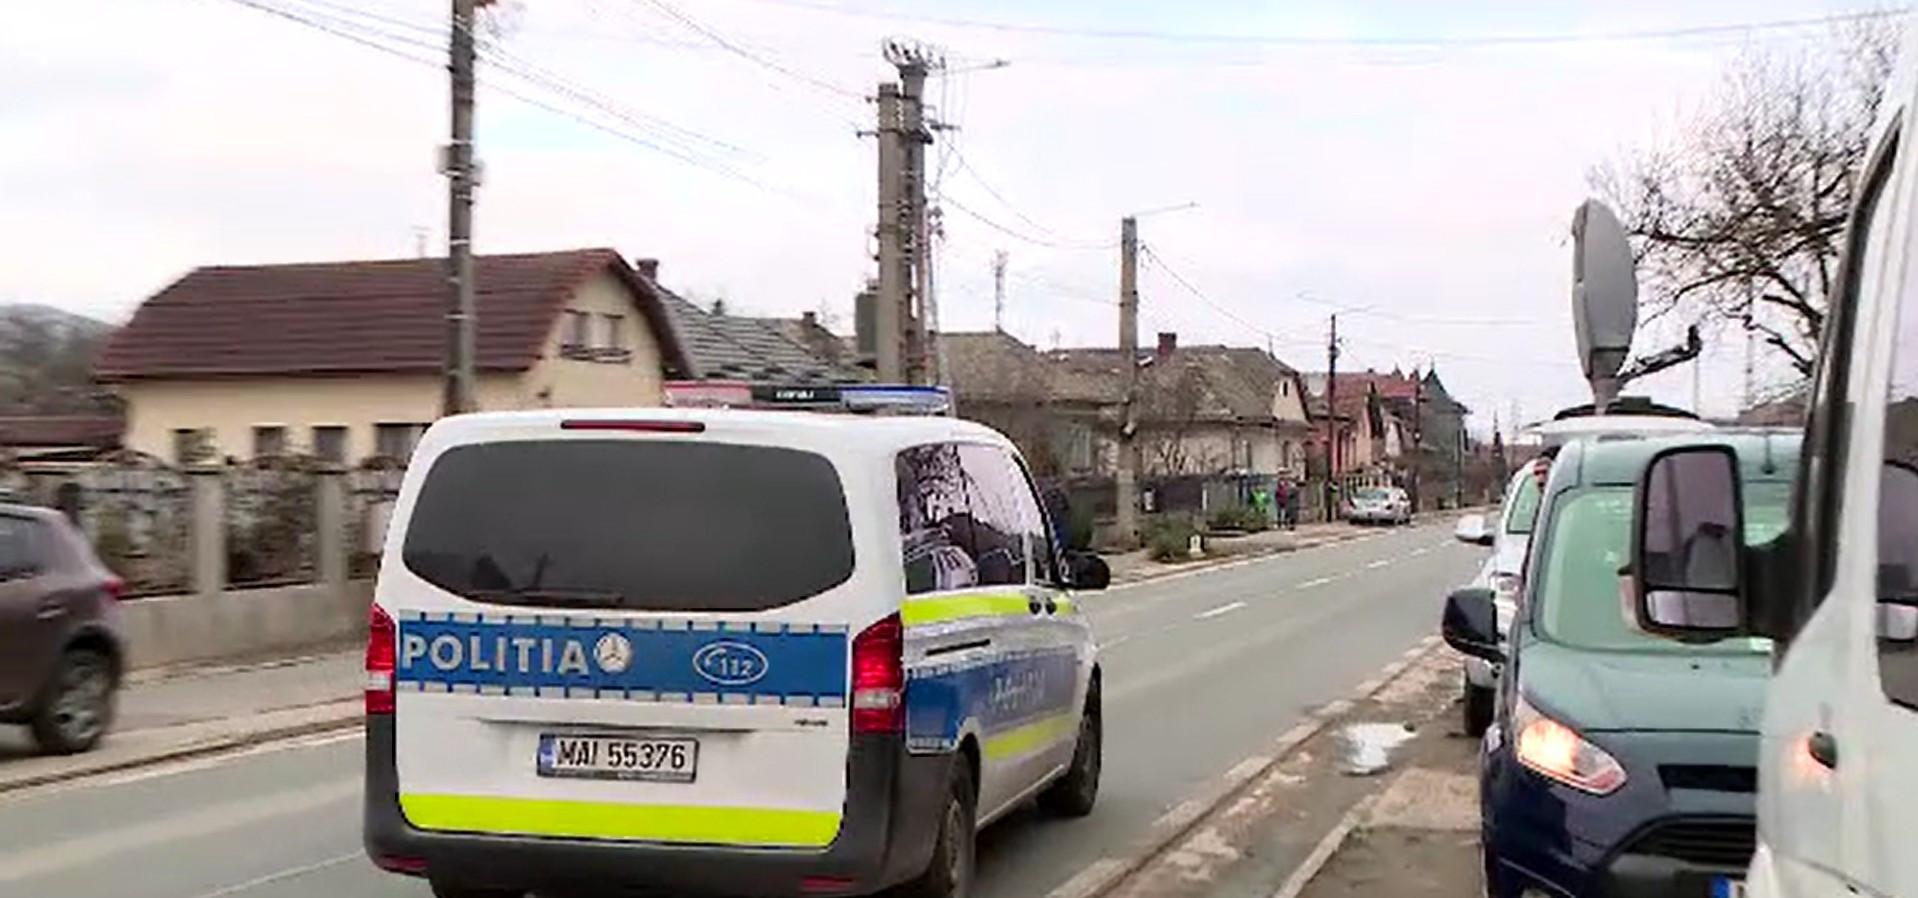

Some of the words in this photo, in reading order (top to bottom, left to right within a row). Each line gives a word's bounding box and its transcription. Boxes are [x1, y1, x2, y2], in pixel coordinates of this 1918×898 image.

[721, 657, 754, 678] 112
[557, 741, 599, 766] MAI
[607, 742, 686, 770] 55376
